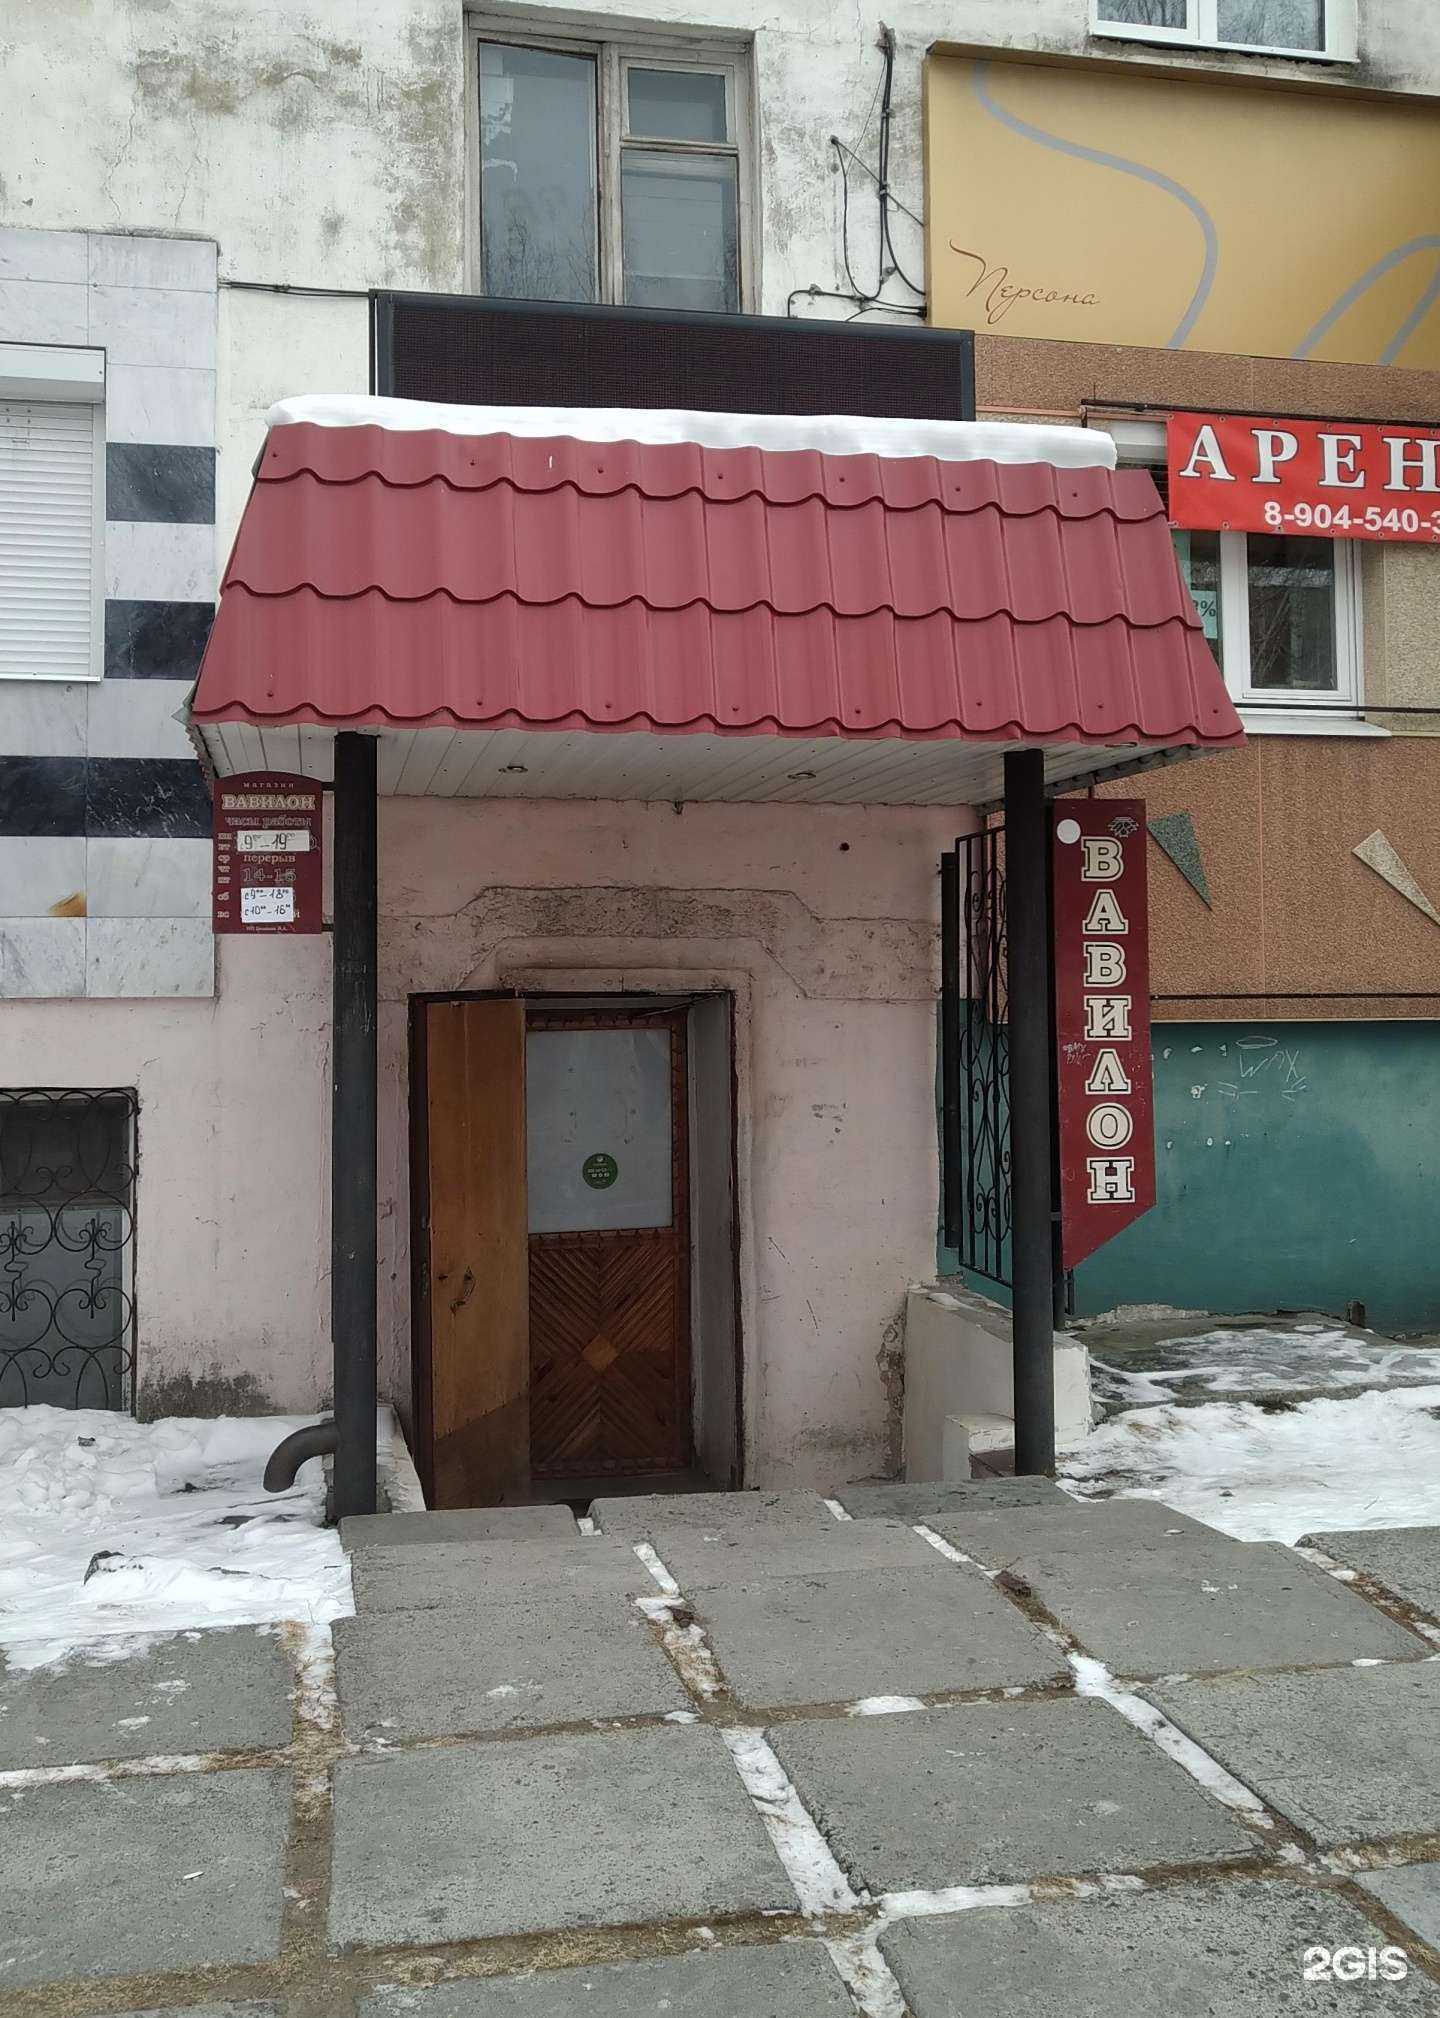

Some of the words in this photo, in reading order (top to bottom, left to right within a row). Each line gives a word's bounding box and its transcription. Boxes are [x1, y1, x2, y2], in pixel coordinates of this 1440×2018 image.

[949, 239, 1101, 325] Персона
[221, 793, 316, 810] ВАВИЛОН
[225, 816, 261, 827] часы
[262, 814, 312, 829] работы
[243, 854, 296, 865] перерыв
[1080, 835, 1137, 1204] ВАВИЛОН
